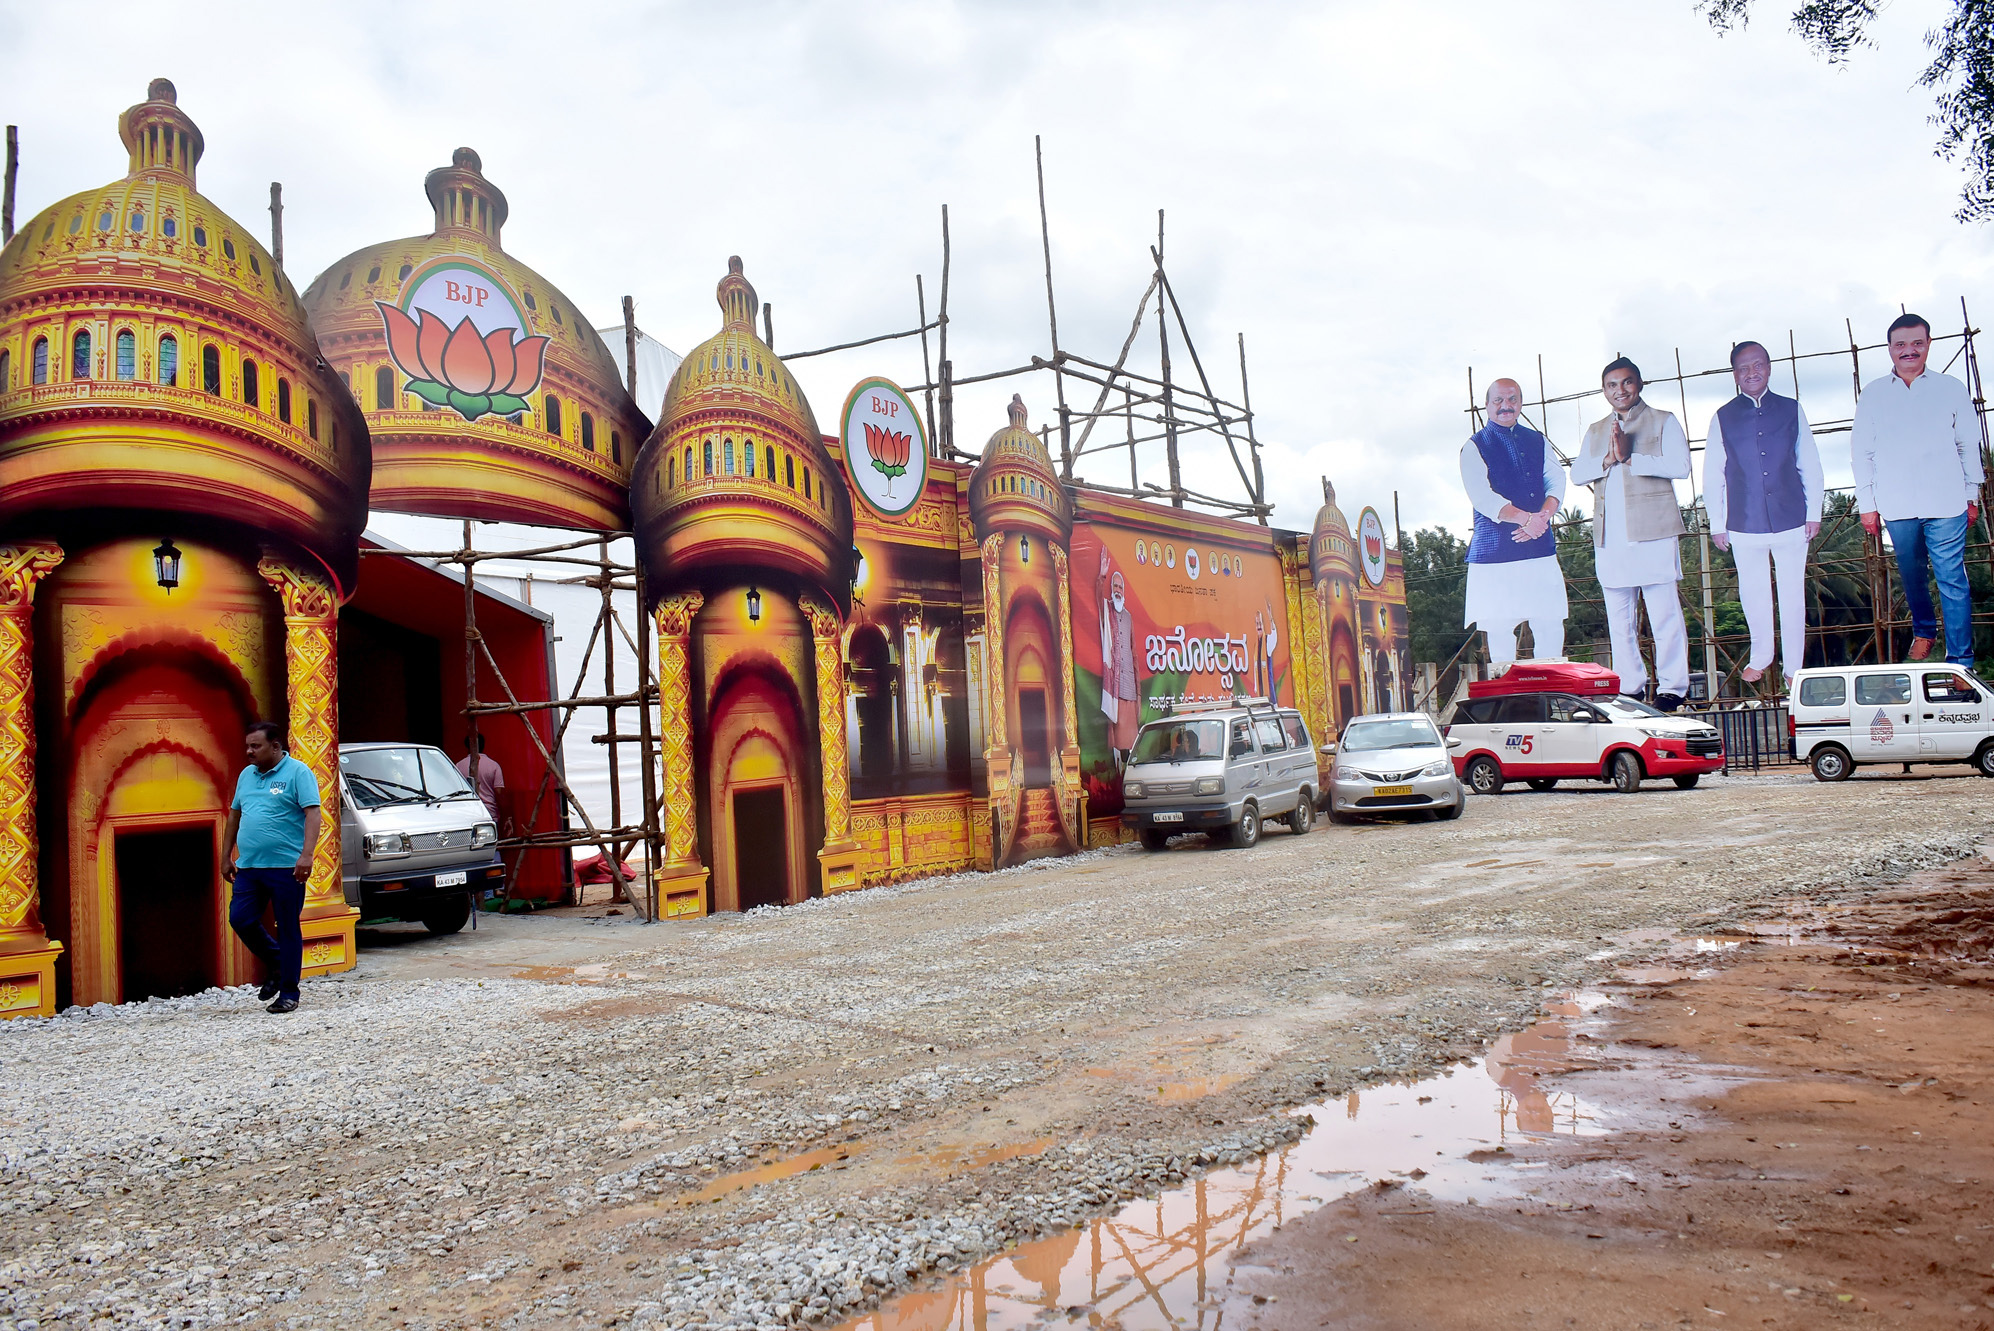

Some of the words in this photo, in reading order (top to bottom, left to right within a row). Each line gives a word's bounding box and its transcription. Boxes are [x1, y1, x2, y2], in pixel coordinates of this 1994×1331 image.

[445, 280, 489, 307] BJP
[872, 396, 899, 418] BJP
[1366, 518, 1375, 529] BJP
[1145, 625, 1249, 689] ಜನೋತ್ಸವ
[1938, 713, 1980, 724] ಕನ್ನಡಪ್ರಭ
[1508, 736, 1522, 745] TV
[1521, 735, 1534, 754] 5
[270, 781, 287, 790] USPA
